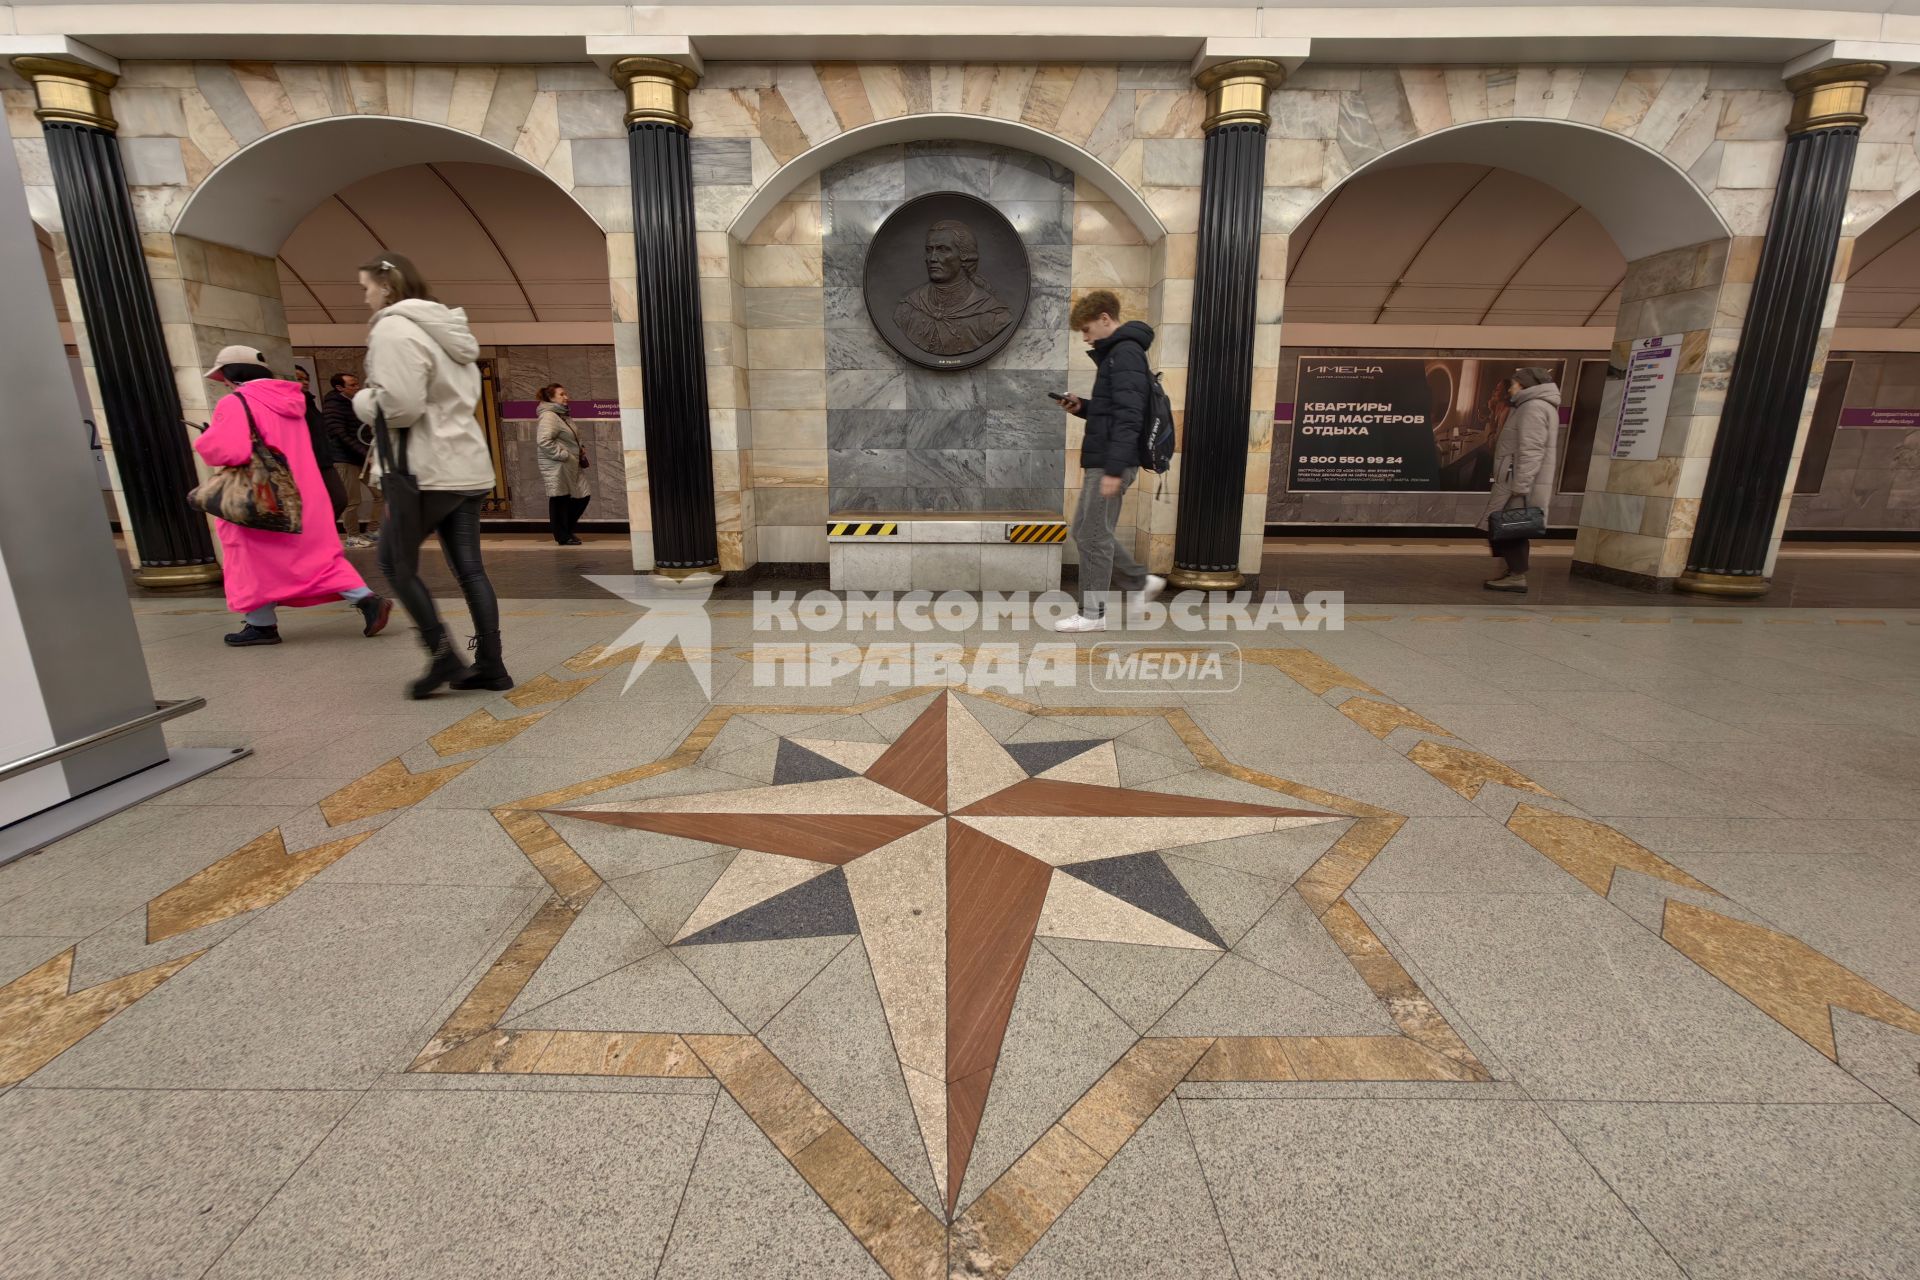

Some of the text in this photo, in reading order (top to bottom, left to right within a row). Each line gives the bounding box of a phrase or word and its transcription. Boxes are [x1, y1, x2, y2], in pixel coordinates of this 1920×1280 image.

[1304, 402, 1392, 412] КВАРТИРЫ
[1303, 414, 1425, 424] ДЛЯ МАСТЕРОВ
[1302, 426, 1369, 436] ОТДЫХА
[1299, 456, 1403, 464] 8 800 550 99 24
